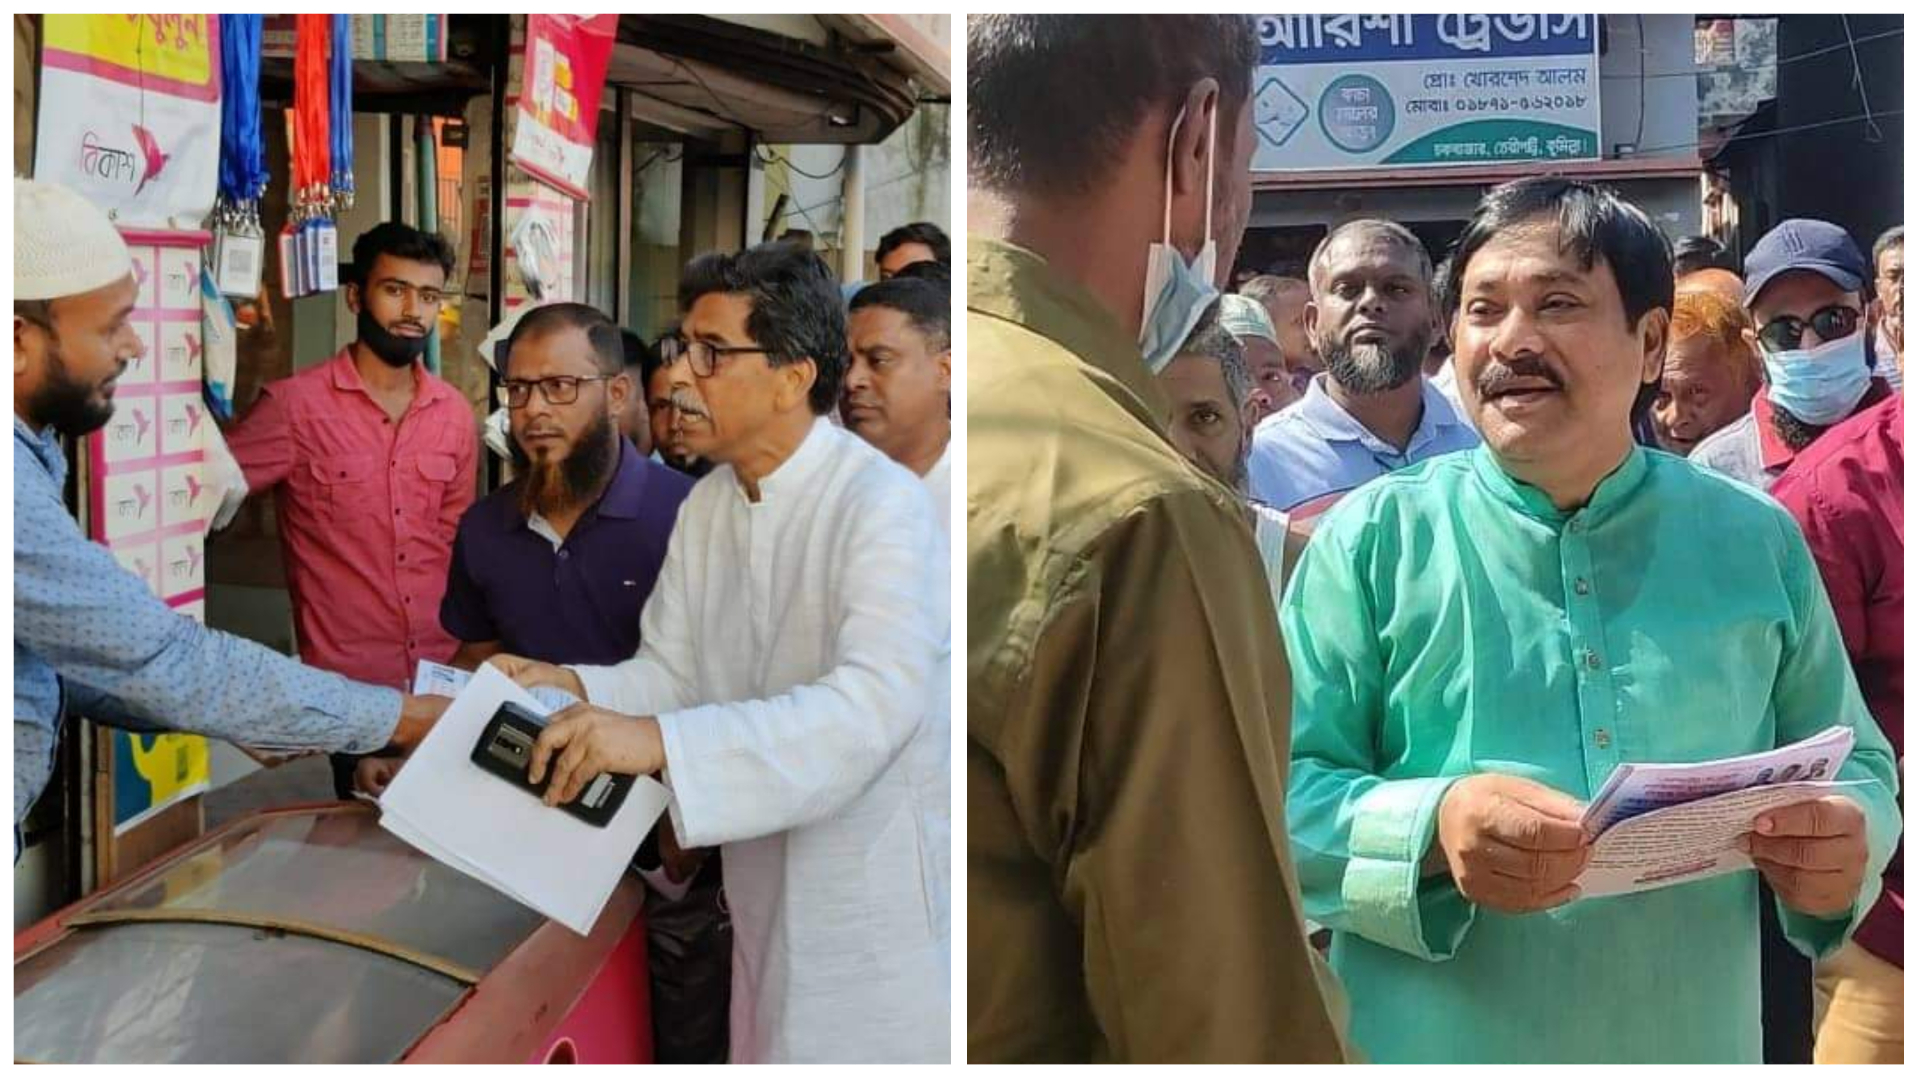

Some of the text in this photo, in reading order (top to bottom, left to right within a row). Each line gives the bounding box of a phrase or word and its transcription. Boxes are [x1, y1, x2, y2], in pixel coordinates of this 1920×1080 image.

[1463, 69, 1529, 89] খোরশেদ
[1537, 67, 1586, 86] আলম
[80, 130, 136, 182] বিকাশ
